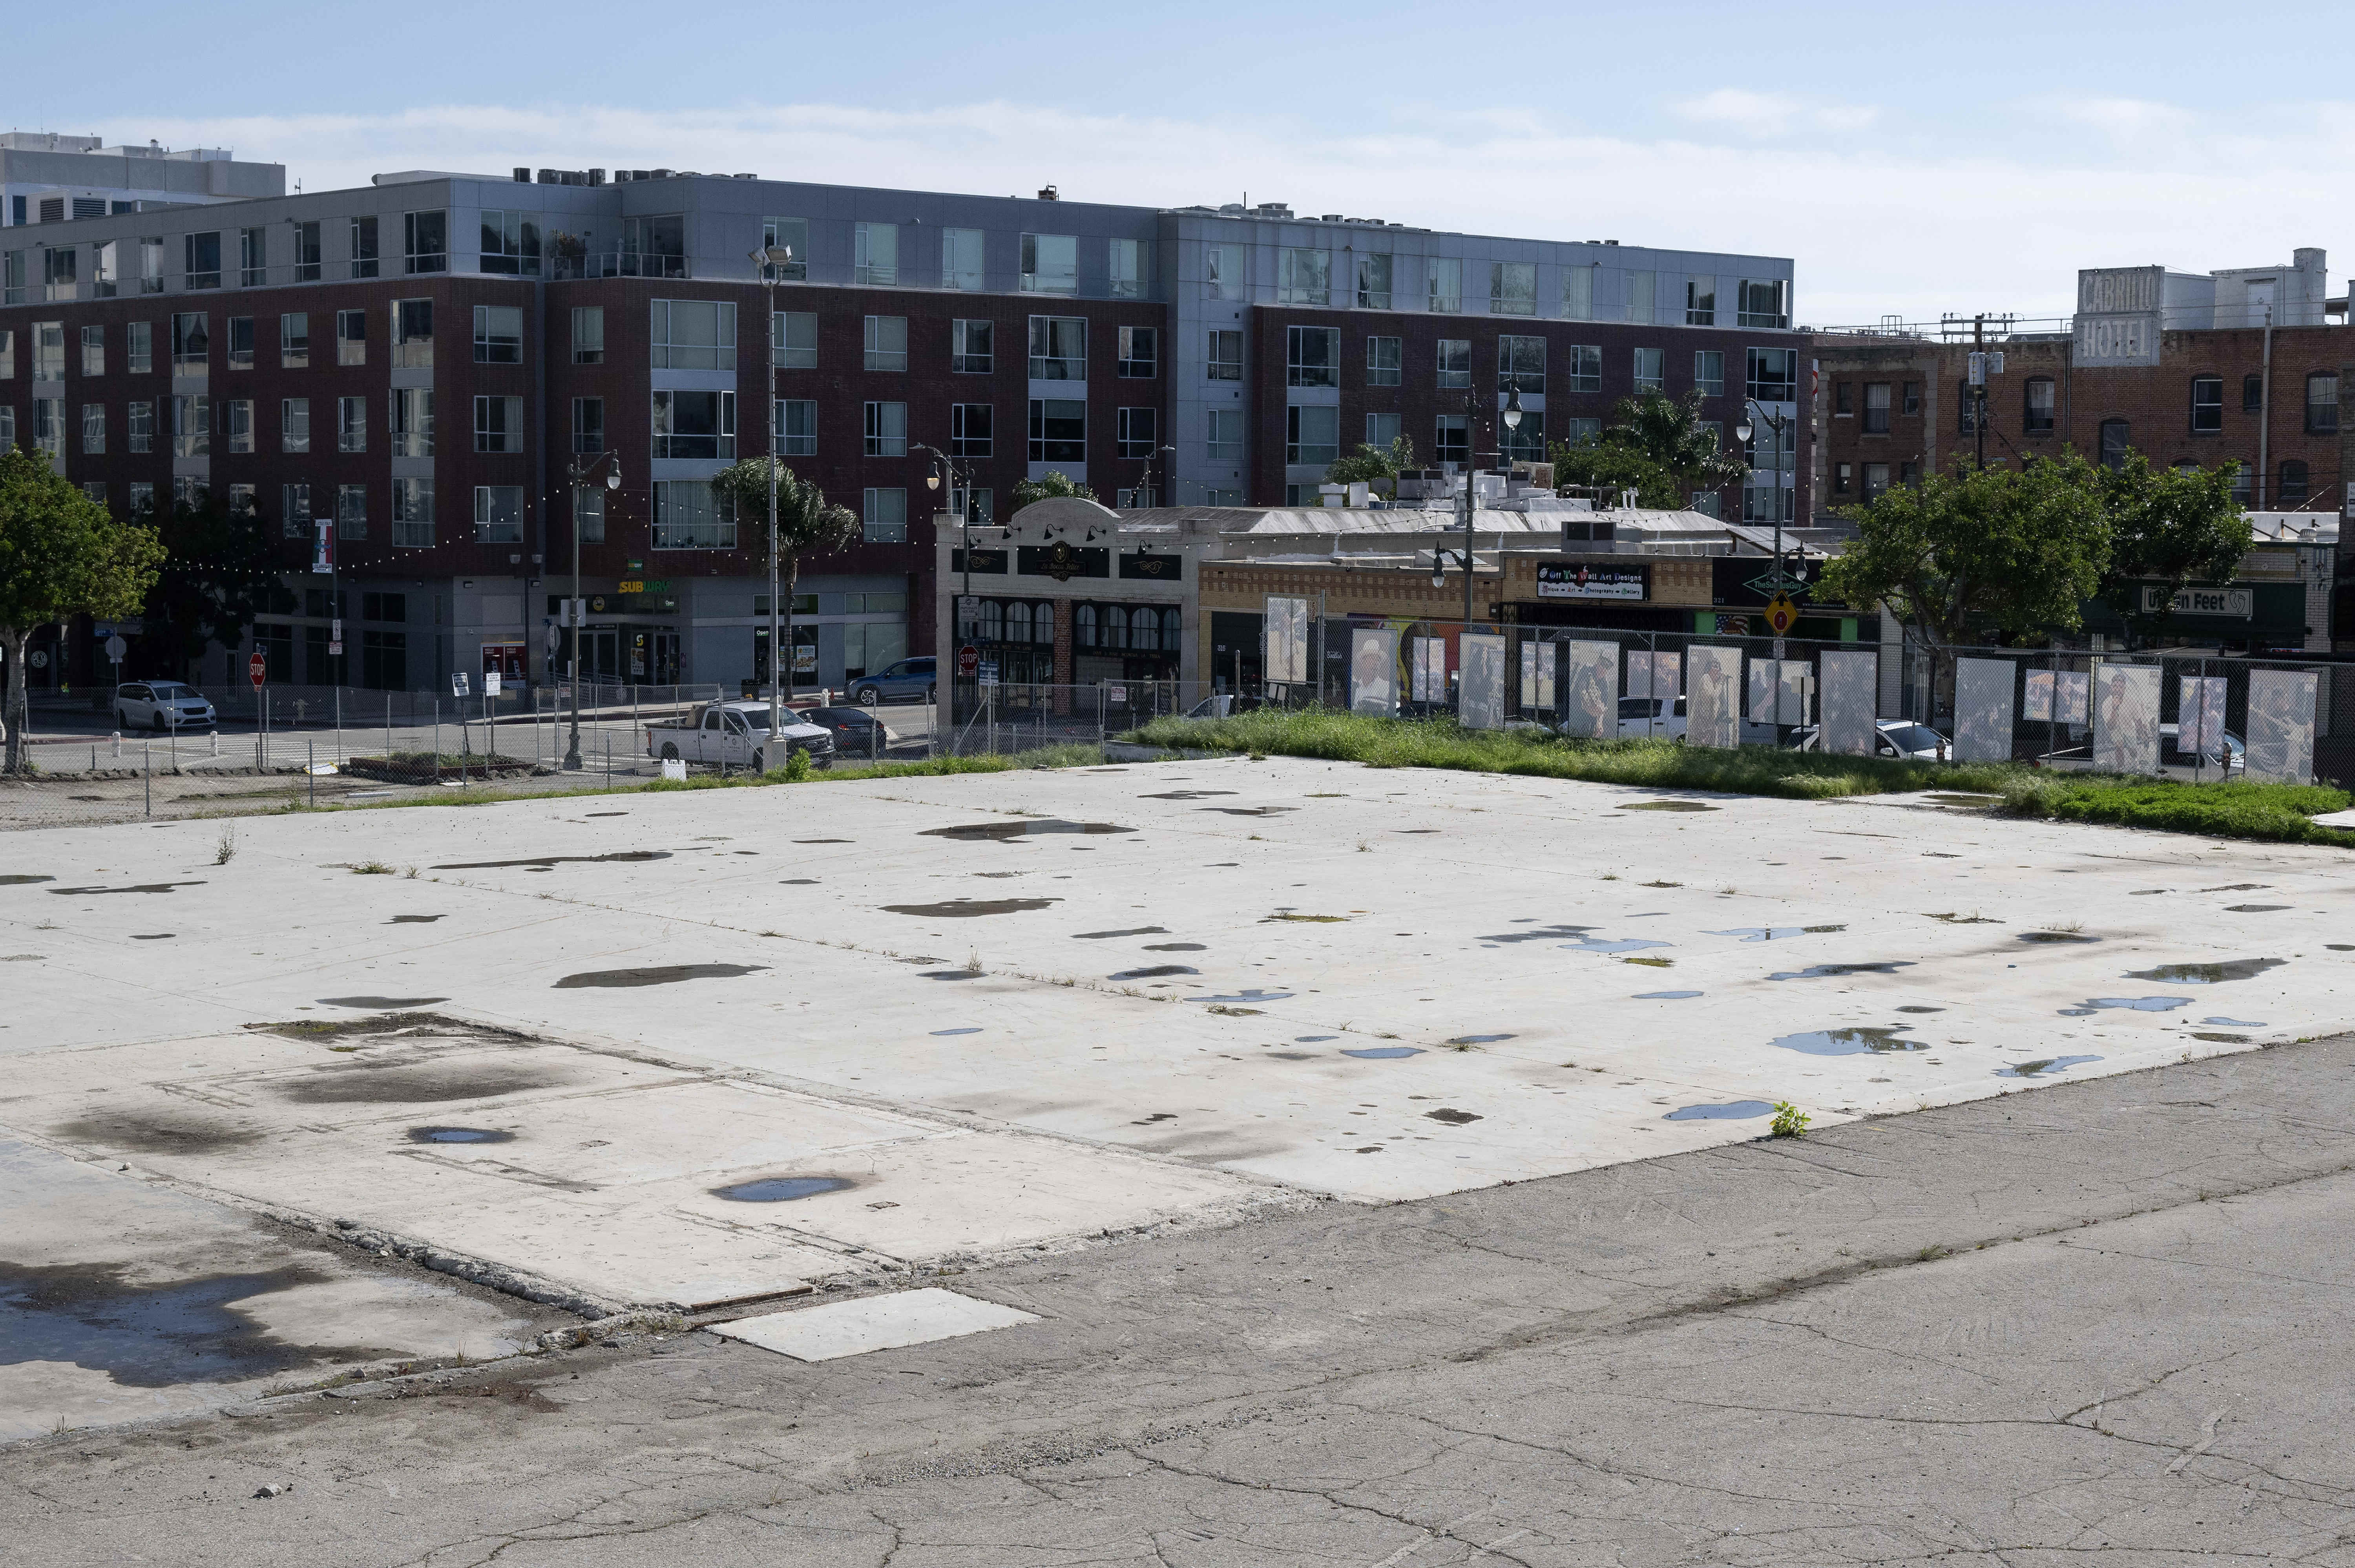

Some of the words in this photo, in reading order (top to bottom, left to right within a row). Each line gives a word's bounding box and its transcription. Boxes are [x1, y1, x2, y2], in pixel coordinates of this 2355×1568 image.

[2082, 273, 2155, 312] CABRILLO
[2083, 319, 2150, 357] HOTEL
[1564, 570, 1577, 580] The
[1579, 572, 1597, 581] Wall
[1614, 573, 1642, 582] Designs
[618, 581, 672, 593] SUBWAY
[1542, 585, 1559, 594] Unique
[1754, 581, 1802, 590] TheSulusGuy
[2194, 593, 2225, 610] Feet
[960, 654, 977, 664] STOP
[251, 664, 264, 676] STOP
